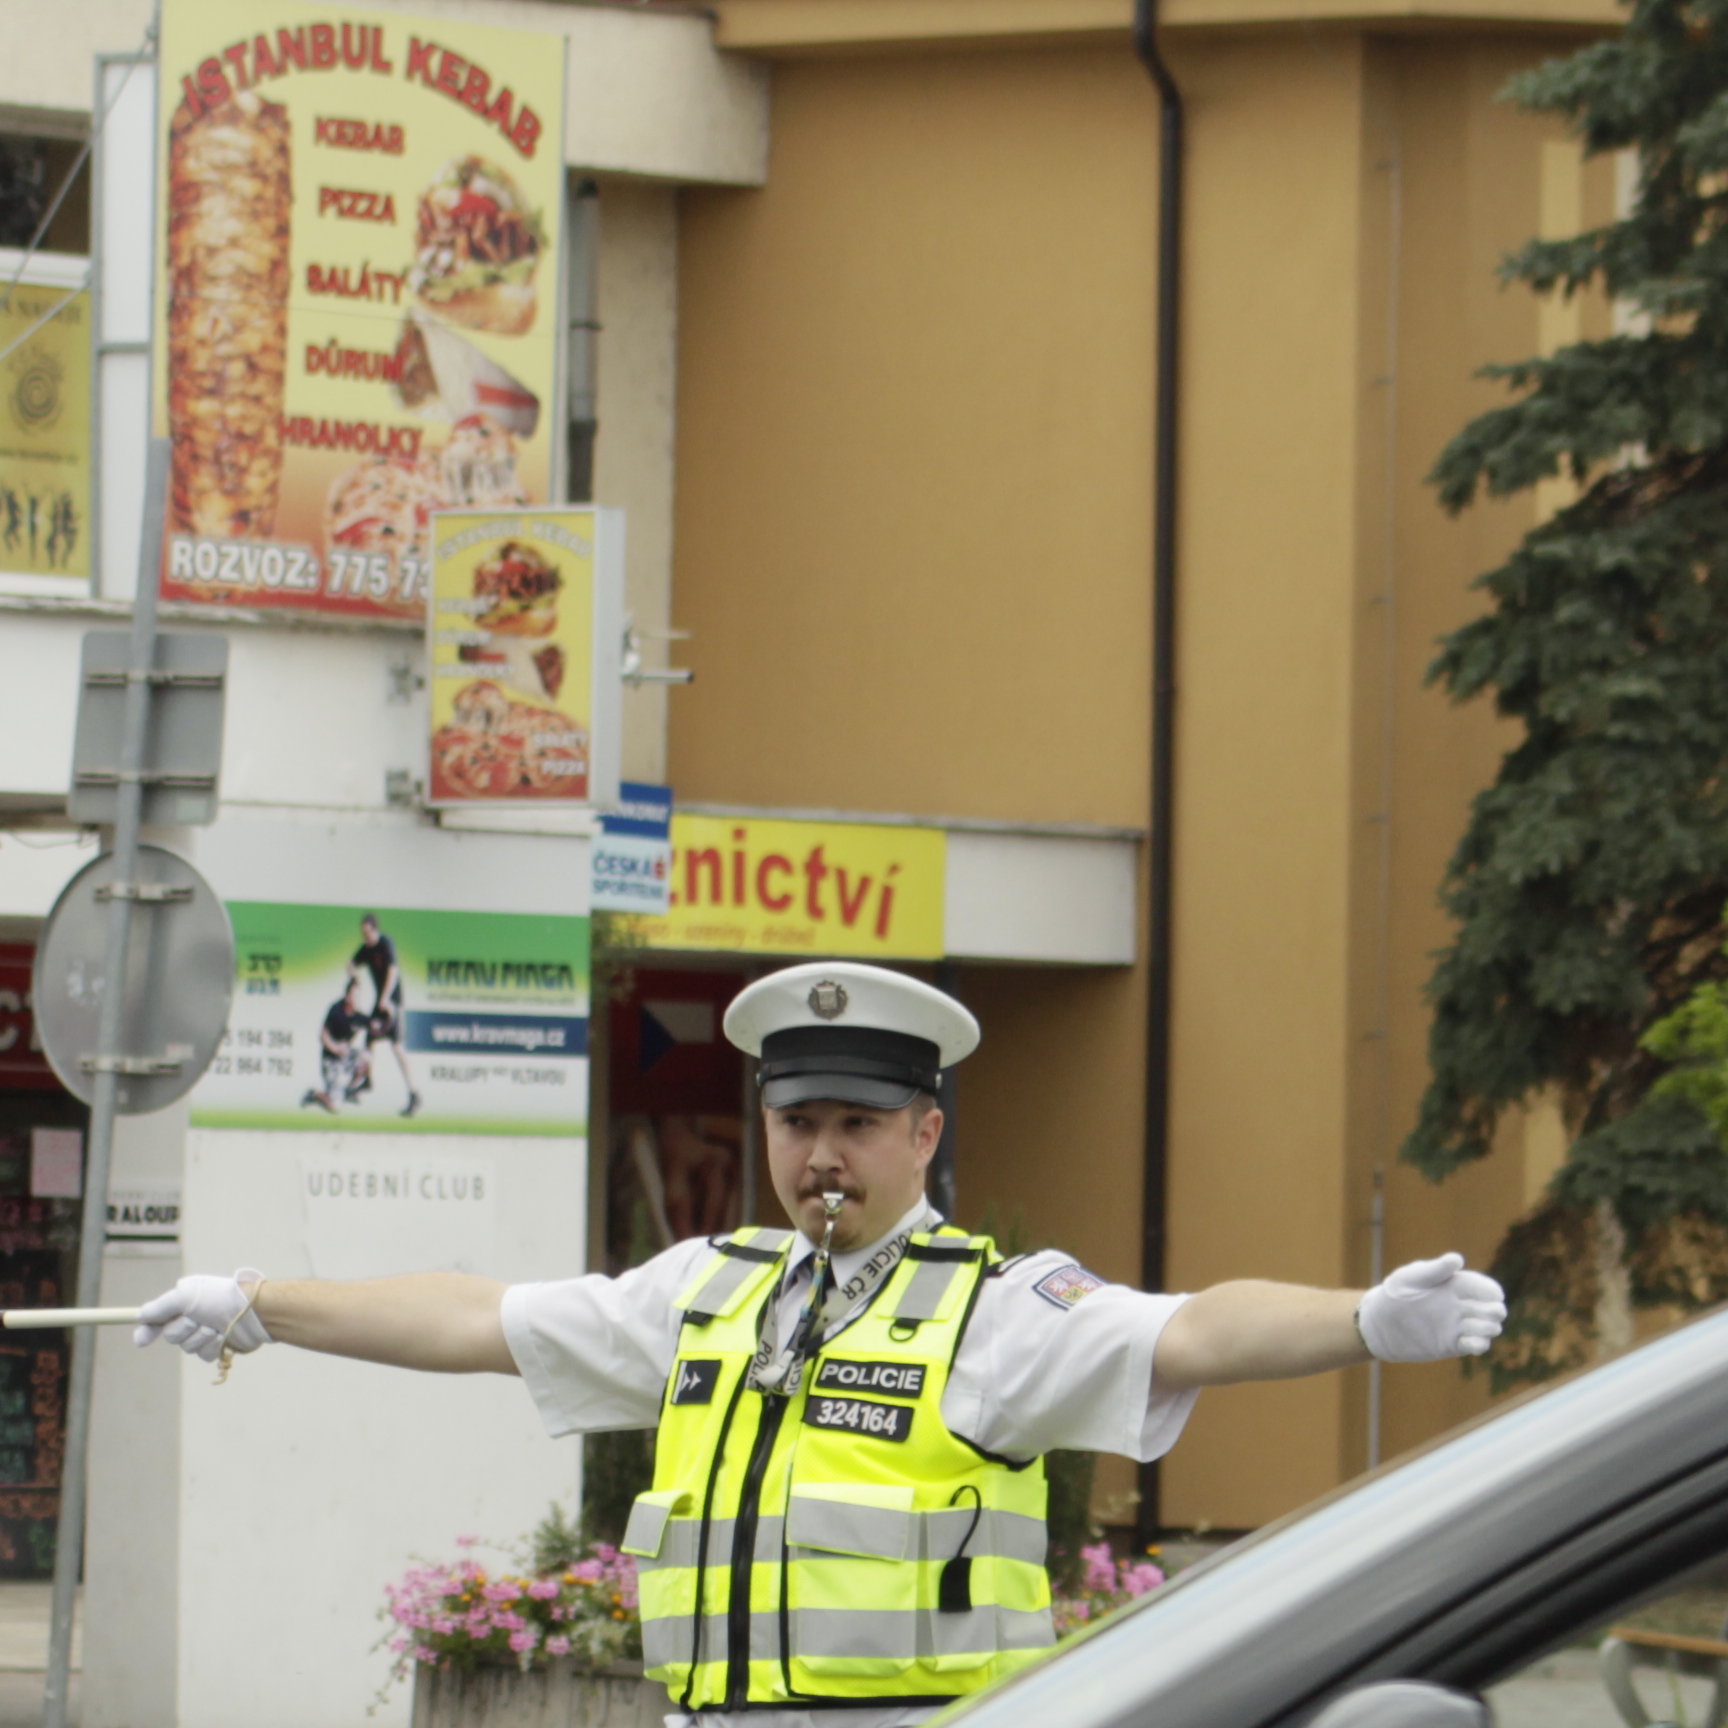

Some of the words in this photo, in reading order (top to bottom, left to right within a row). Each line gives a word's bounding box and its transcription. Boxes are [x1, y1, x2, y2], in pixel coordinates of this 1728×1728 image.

[181, 22, 393, 119] ISTANBUL
[405, 35, 544, 161] KEBAB
[314, 116, 406, 157] KEBAB
[319, 186, 397, 226] PIZZA
[277, 414, 424, 463] HRANOLKY
[170, 539, 319, 588] ROZVOZ:
[328, 552, 390, 597] 775
[426, 959, 497, 988] KRAV
[500, 961, 575, 991] MAGA
[431, 1021, 567, 1052] www.kravmaga.cz
[420, 1174, 486, 1201] CLUB
[106, 1205, 180, 1223] RALOUP
[863, 1227, 913, 1278] OLICIE
[841, 1276, 868, 1300] ČR
[821, 1363, 923, 1391] POLICIE
[817, 1401, 899, 1435] 324164
